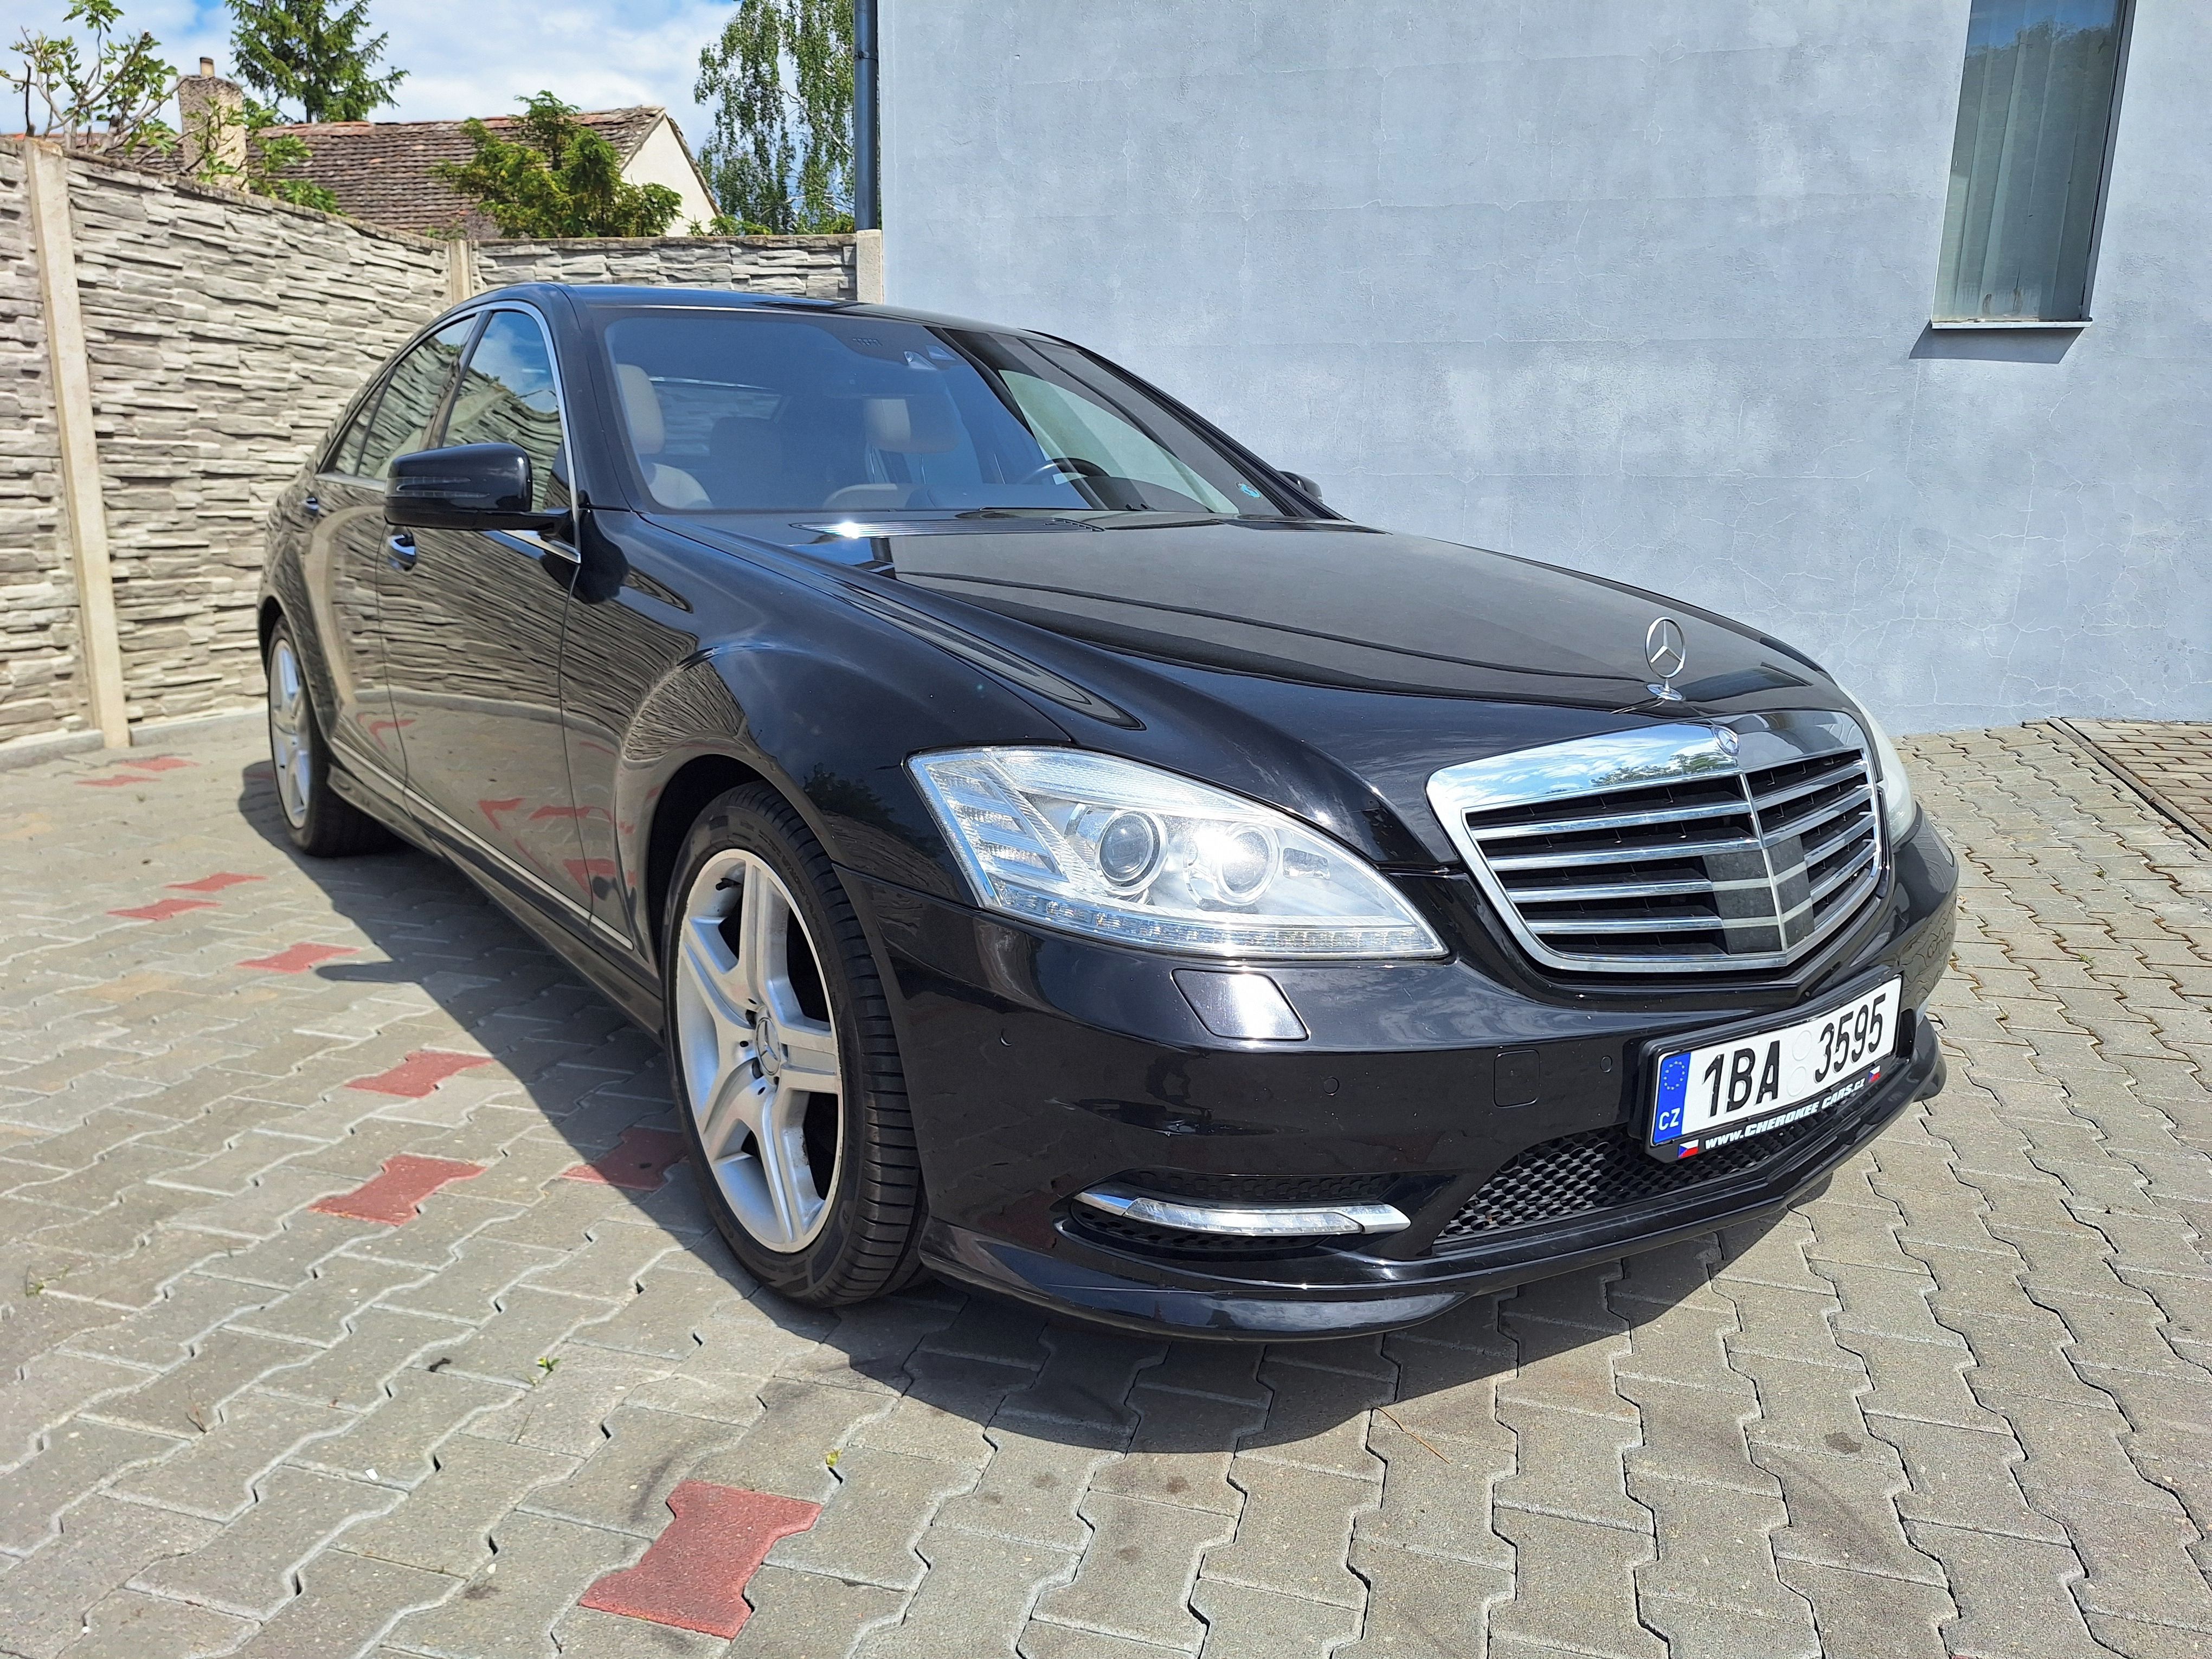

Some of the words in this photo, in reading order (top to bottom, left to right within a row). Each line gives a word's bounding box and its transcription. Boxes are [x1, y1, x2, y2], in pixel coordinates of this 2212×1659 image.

[1703, 1040, 1780, 1117] 1BA
[1814, 992, 1886, 1084] 3595
[1658, 1108, 1680, 1131] CZ
